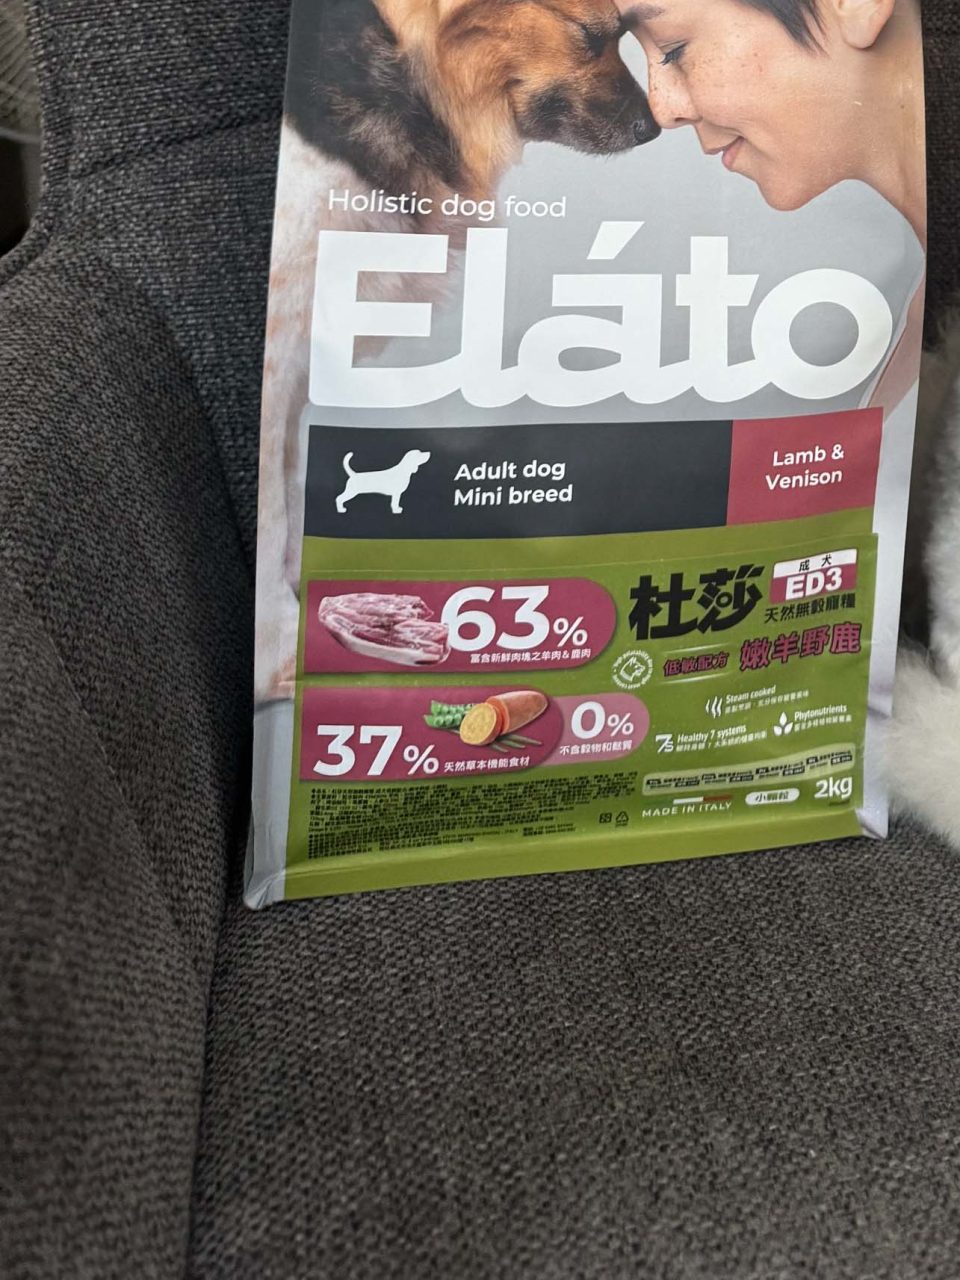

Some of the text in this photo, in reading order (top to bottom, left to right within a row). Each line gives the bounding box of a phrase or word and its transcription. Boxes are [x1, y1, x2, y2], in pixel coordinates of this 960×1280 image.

[328, 189, 567, 221] Holistic dog food
[308, 221, 893, 408] Eláto
[773, 444, 844, 466] Lamb &
[454, 460, 566, 480] Adult dog
[765, 470, 842, 490] Venison
[454, 484, 573, 506] Mini breed
[785, 567, 842, 600] ED3
[441, 585, 588, 652] 63%
[740, 621, 862, 672] 嫩羊野鹿
[725, 692, 749, 704] Steam
[750, 685, 776, 700] cooked
[571, 701, 634, 739] 0%
[794, 704, 848, 722] Phytonutrients
[677, 731, 709, 743] Healthy
[717, 723, 747, 739] systems
[313, 724, 439, 776] 37%
[814, 776, 853, 800] 2kg
[642, 801, 732, 817] MADE IN ITALY
